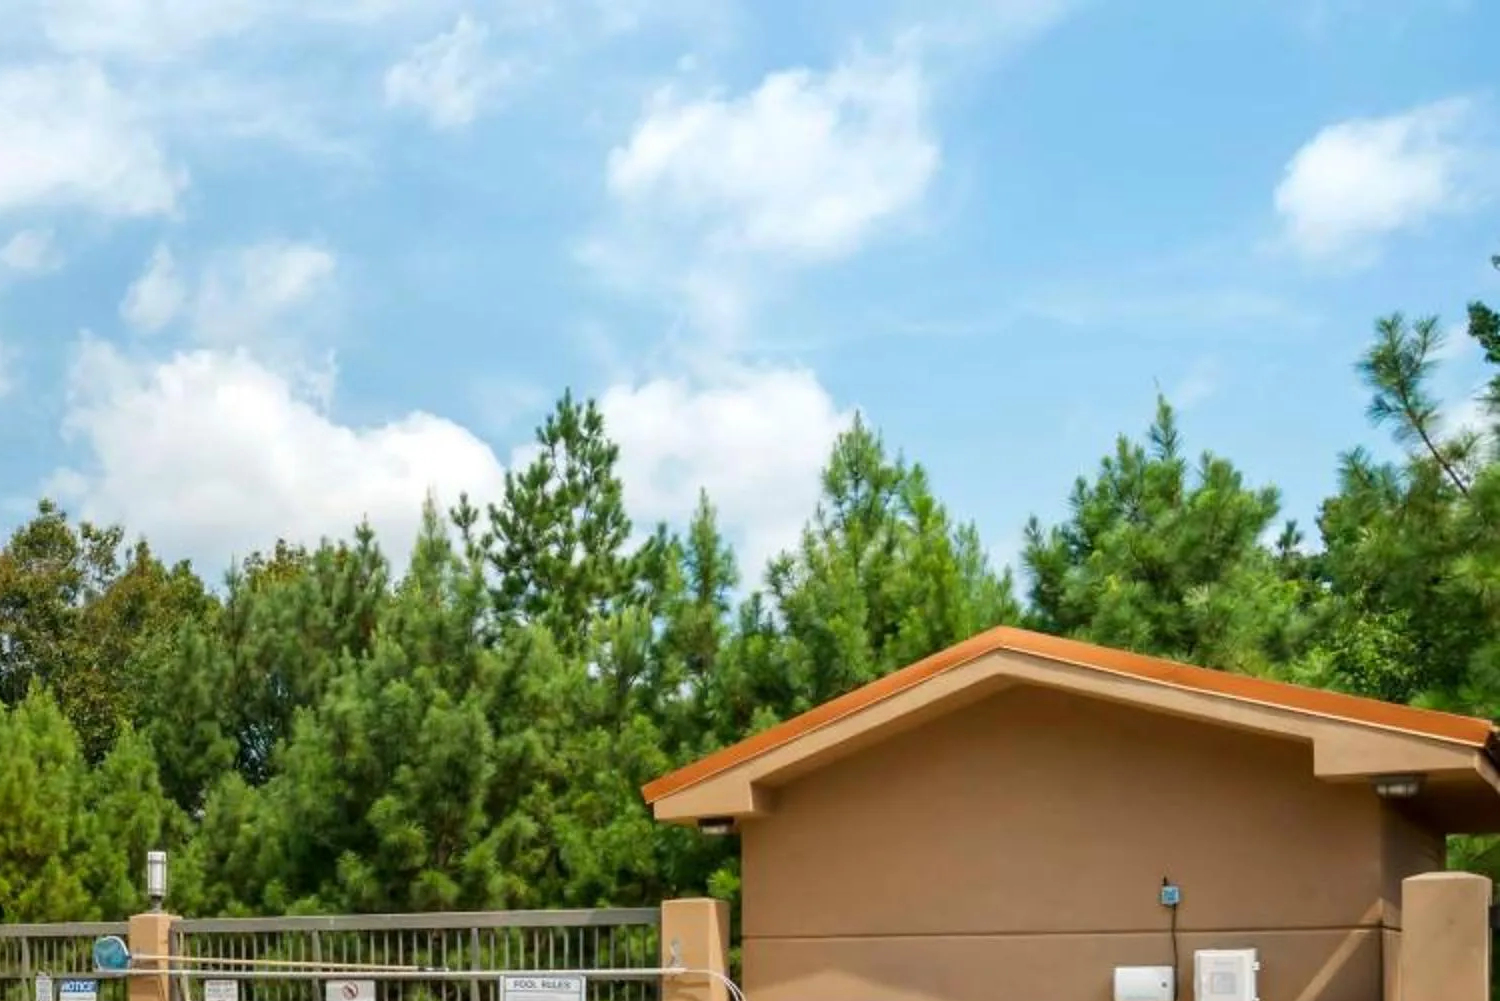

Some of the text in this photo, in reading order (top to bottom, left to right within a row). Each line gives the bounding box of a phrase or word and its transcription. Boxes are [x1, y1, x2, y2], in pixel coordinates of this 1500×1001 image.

[62, 980, 95, 991] NOTICE
[513, 979, 571, 989] POOL RULES
